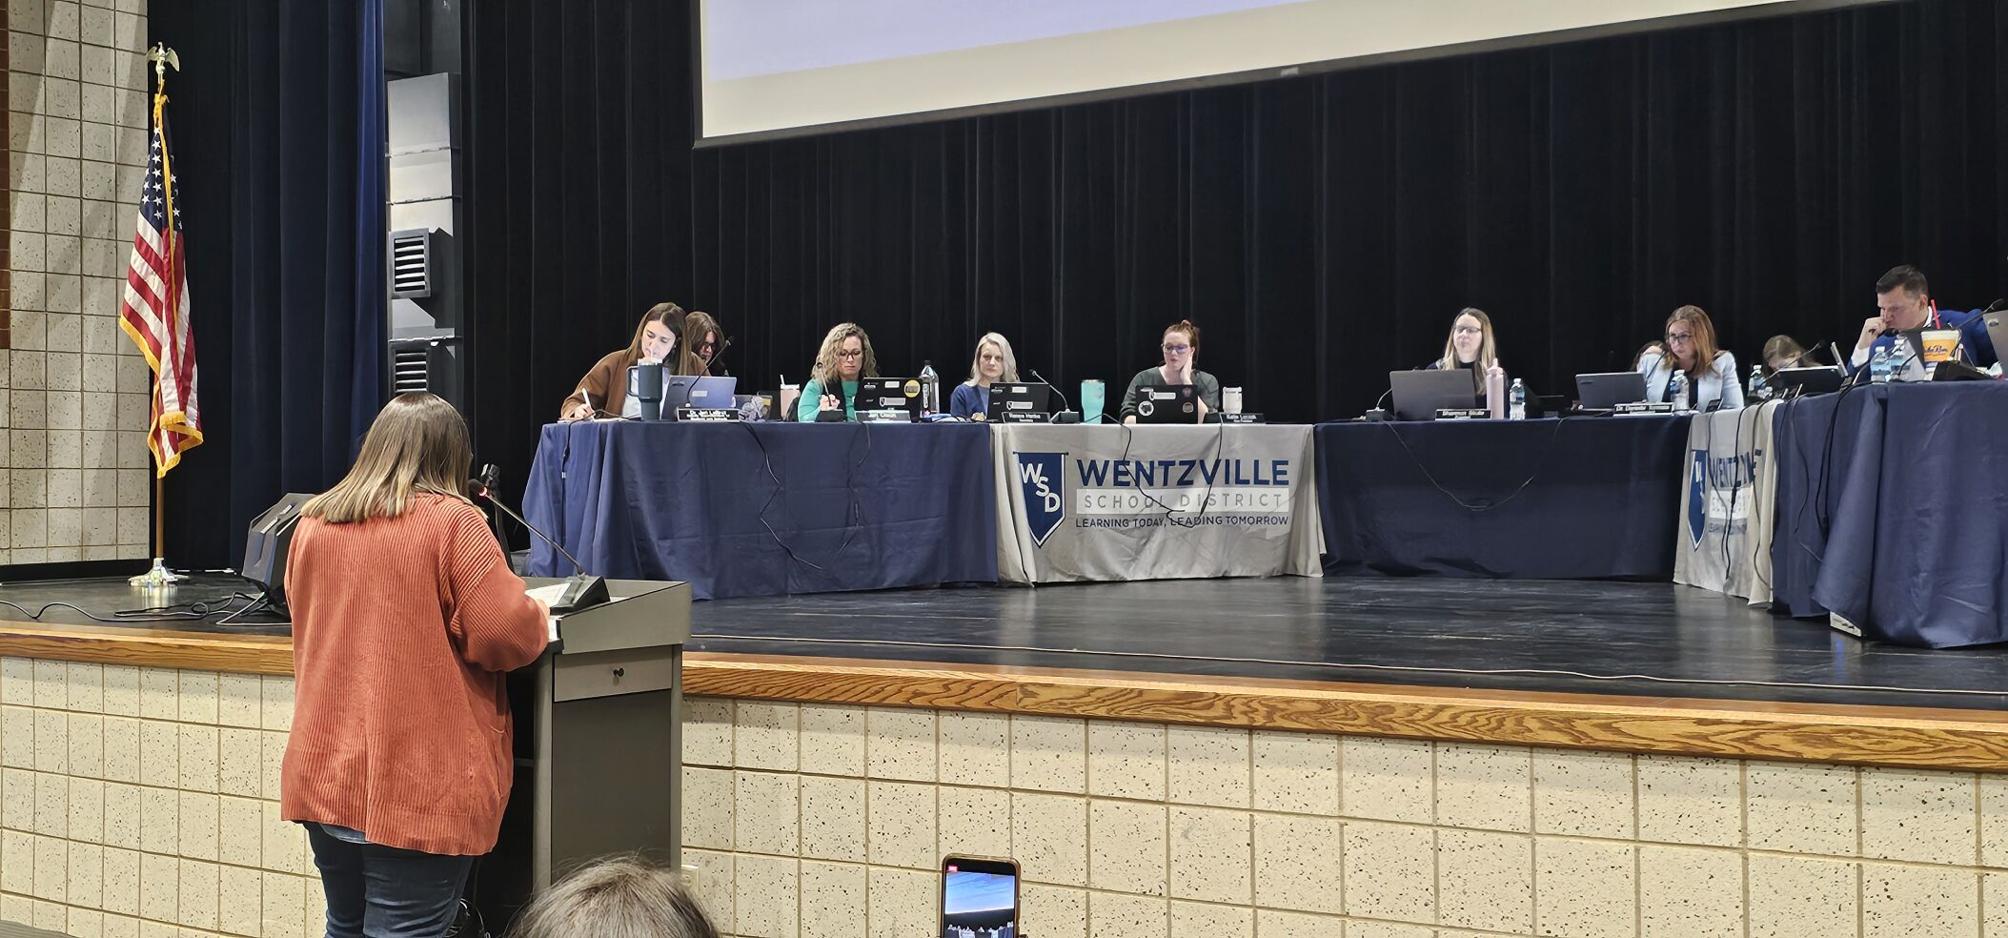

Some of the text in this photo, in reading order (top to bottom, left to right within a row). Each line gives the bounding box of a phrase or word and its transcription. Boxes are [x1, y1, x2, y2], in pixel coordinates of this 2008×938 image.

[1076, 459, 1290, 487] WENTZVILLE
[1020, 463, 1061, 513] WSD
[1083, 493, 1283, 509] SCHOOL DISTRICT
[1075, 515, 1289, 529] LEARNING TODAY, LEADING TOMORROW
